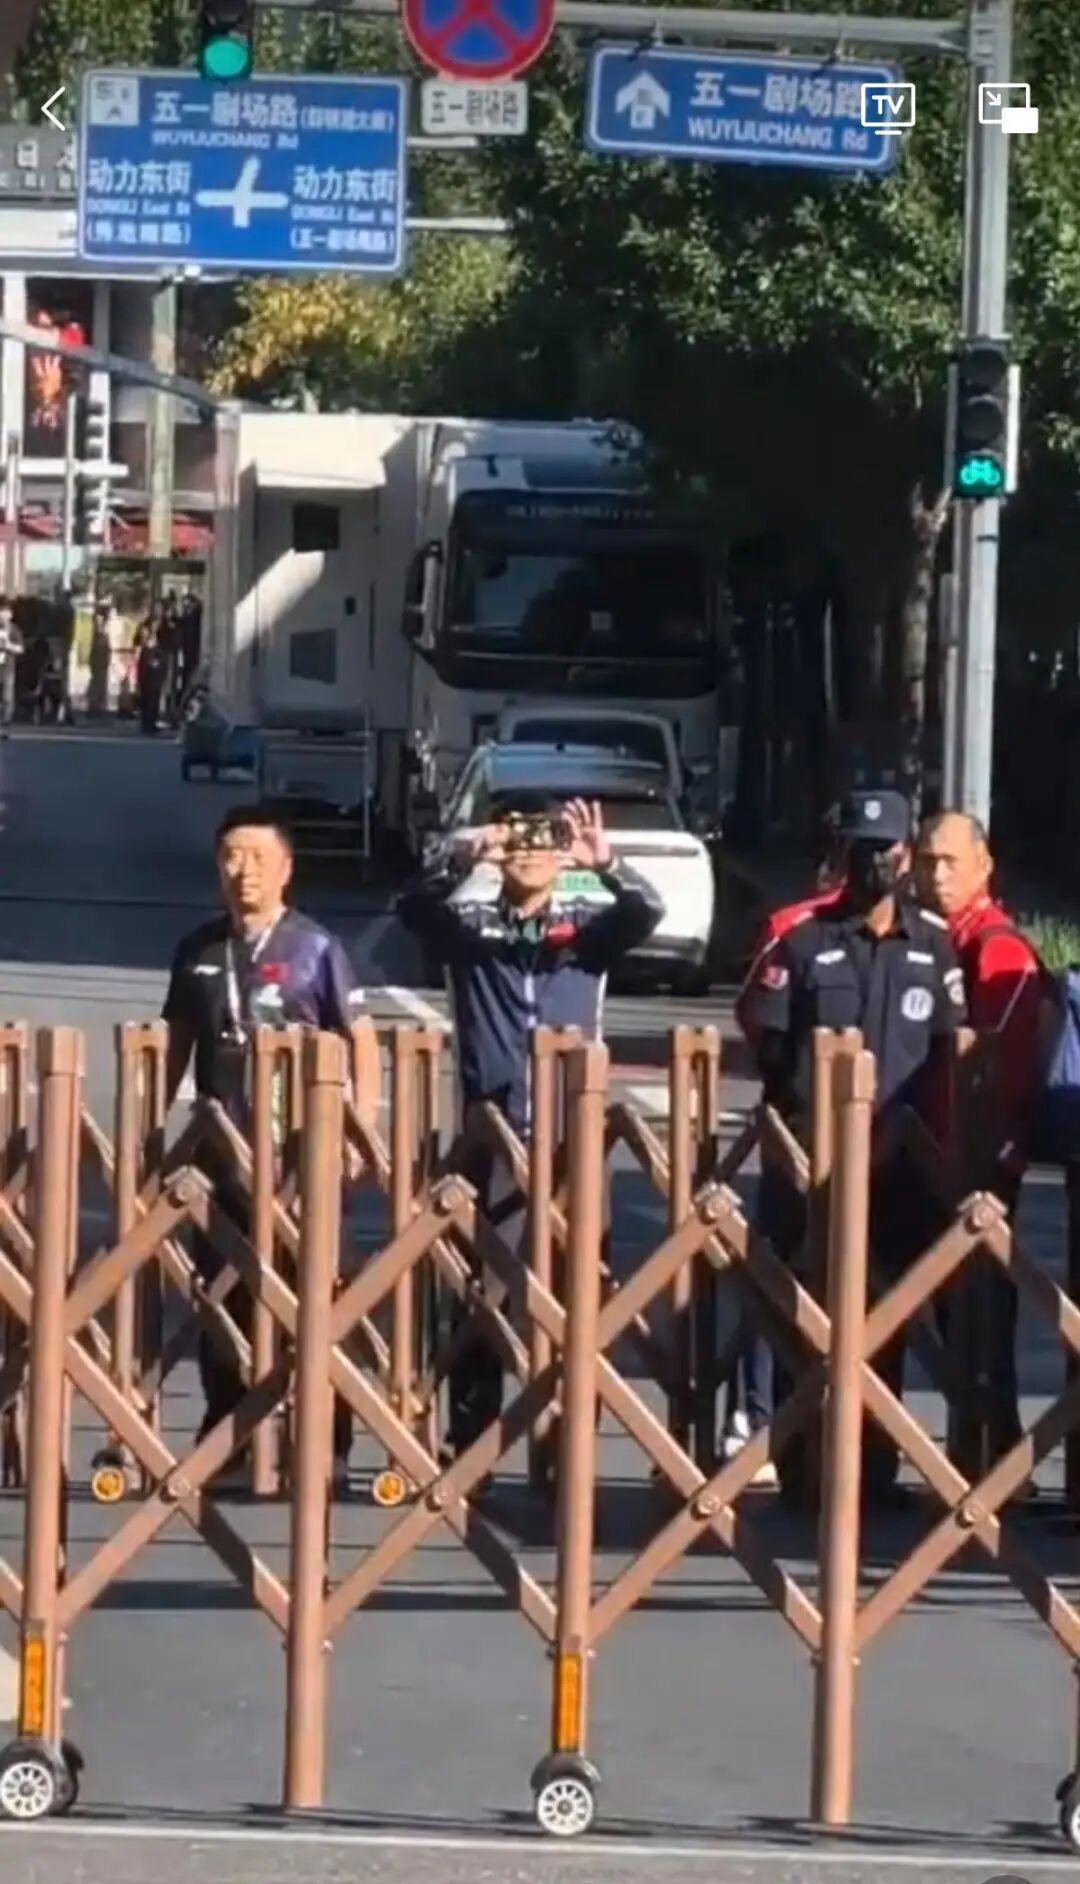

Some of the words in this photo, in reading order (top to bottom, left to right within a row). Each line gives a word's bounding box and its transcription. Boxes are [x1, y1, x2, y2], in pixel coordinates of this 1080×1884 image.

[153, 91, 298, 128] 五一剧场路
[688, 71, 863, 119] 五一剧场路
[842, 127, 868, 150] Rd
[89, 158, 191, 195] 动力东街
[293, 165, 397, 203] 动力东街
